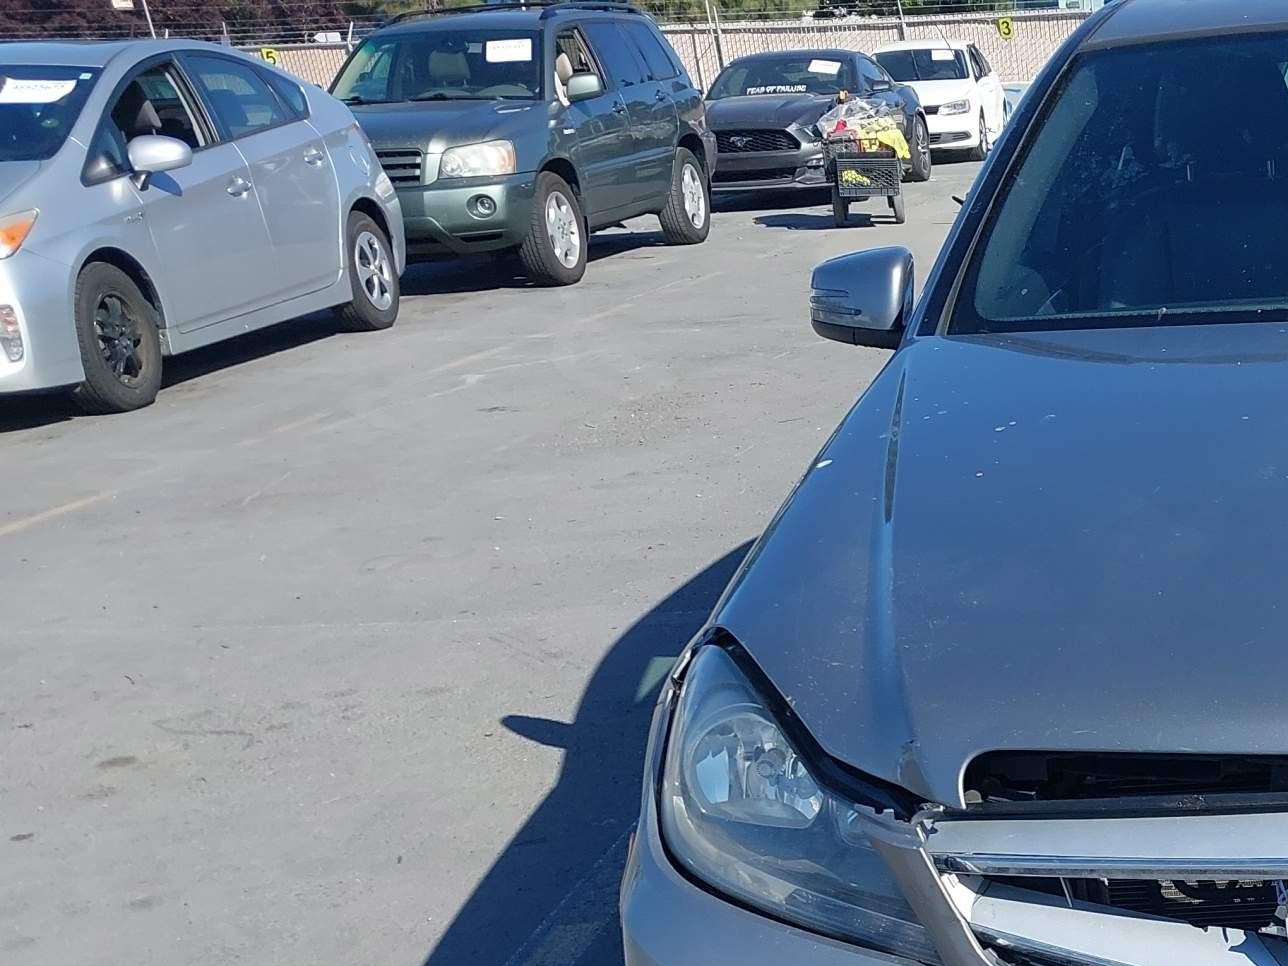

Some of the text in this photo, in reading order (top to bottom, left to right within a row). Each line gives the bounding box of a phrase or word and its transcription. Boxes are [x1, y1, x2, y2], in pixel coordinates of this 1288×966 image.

[1001, 20, 1011, 36] 3
[265, 50, 276, 65] 5
[766, 85, 776, 94] OF
